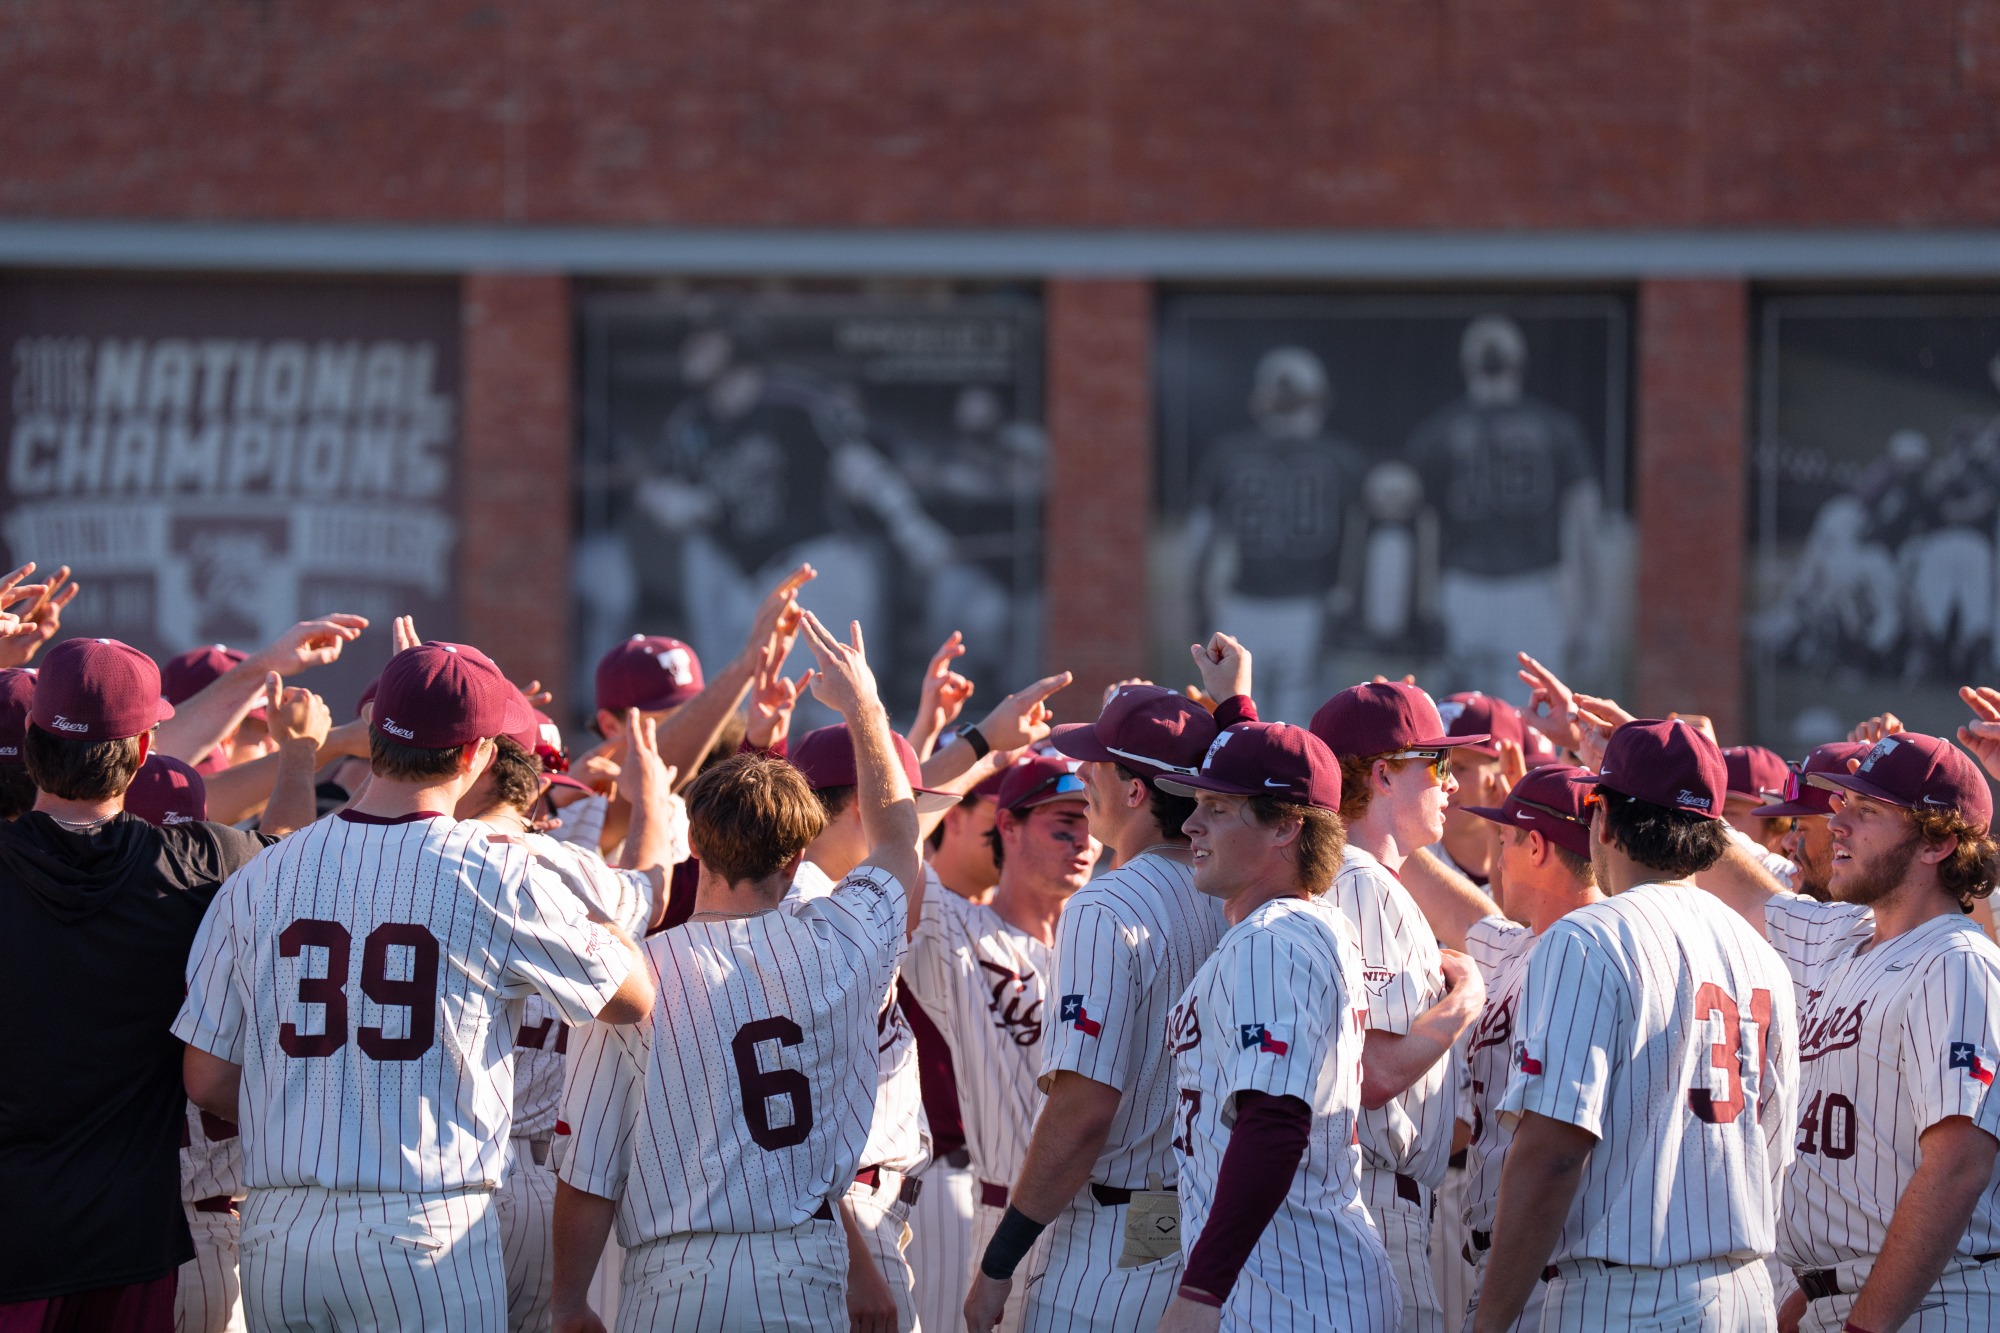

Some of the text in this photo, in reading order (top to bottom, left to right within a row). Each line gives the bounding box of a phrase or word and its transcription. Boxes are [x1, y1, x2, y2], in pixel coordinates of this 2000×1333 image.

[95, 337, 450, 413] NATIONAL
[8, 414, 453, 496] CHAMPIONS
[0, 746, 17, 755] ers
[52, 715, 88, 732] Tigers
[382, 717, 414, 739] Tigers
[1676, 789, 1710, 807] Tigers
[279, 919, 440, 1061] 39
[979, 960, 1043, 1046] Tig
[1362, 971, 1396, 983] NITY
[731, 1015, 813, 1152] 6
[1688, 982, 1771, 1125] 31
[1797, 1089, 1856, 1160] 40
